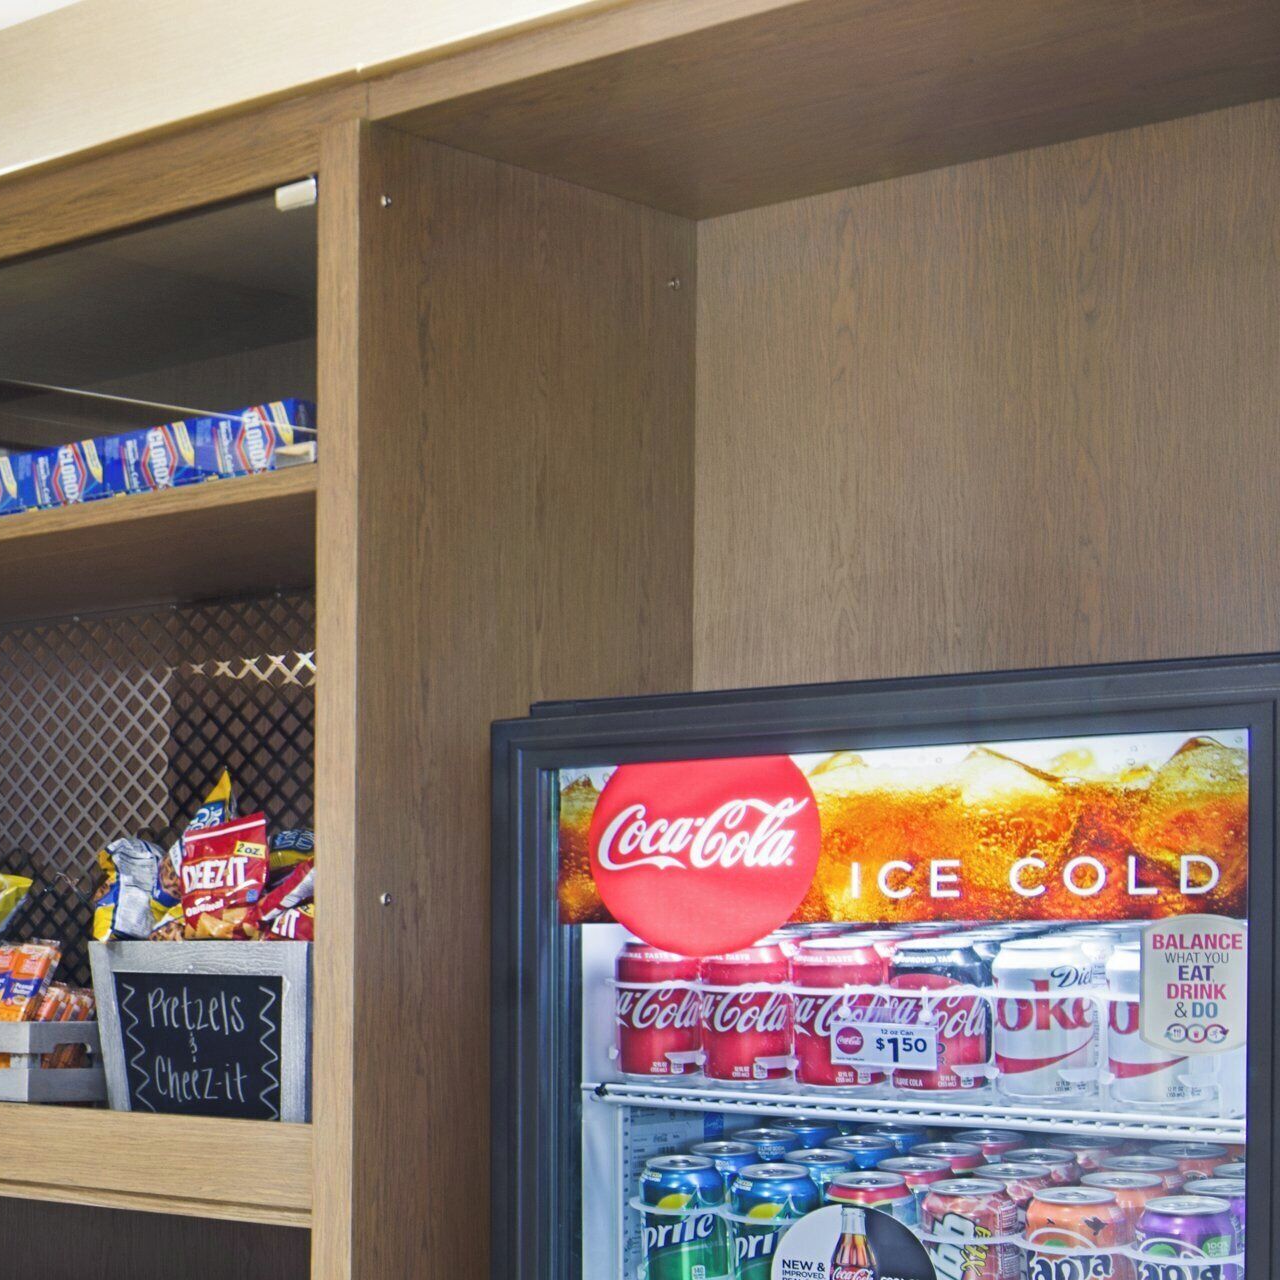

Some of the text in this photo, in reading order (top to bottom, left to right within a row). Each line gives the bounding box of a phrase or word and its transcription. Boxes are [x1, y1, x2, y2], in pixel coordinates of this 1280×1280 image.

[146, 428, 174, 488] CLOROX
[241, 409, 268, 473] CLOROX
[57, 446, 83, 504] CLOROX
[597, 796, 810, 871] Coca-Cola
[849, 853, 1221, 900] ICE COLD
[1152, 933, 1244, 951] BALANCE
[1164, 951, 1230, 964] WHAT YOU
[147, 986, 245, 1035] Pretzels
[1166, 983, 1227, 1000] DRINK
[1174, 1001, 1219, 1019] & DO
[154, 1054, 248, 1103] Cheez-it
[644, 1211, 715, 1251] prite
[782, 1259, 826, 1272] NEW &
